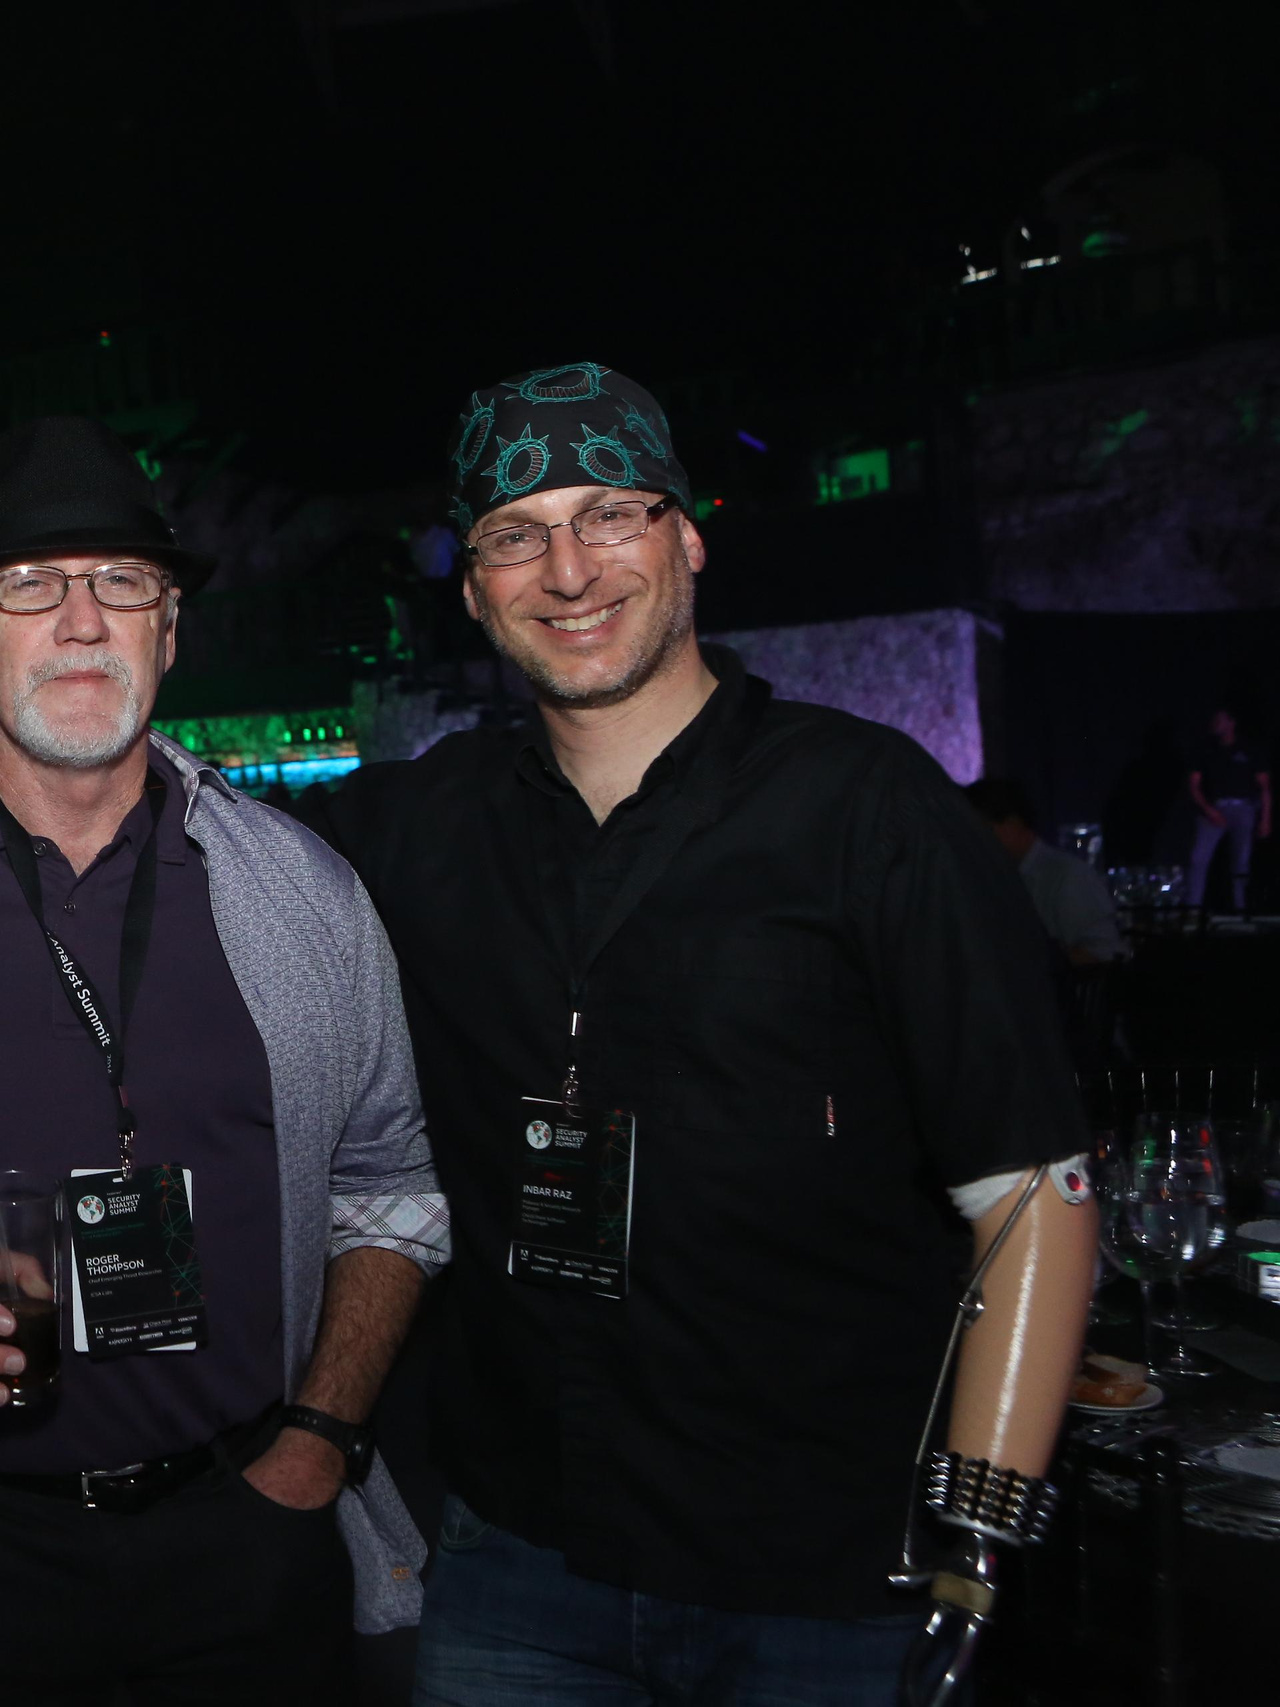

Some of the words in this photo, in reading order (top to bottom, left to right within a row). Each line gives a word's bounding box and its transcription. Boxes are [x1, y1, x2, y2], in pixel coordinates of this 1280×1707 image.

[49, 937, 83, 988] Analyst
[77, 988, 111, 1047] Summit
[555, 1128, 588, 1138] SECURITY
[555, 1134, 584, 1143] ANALYST
[554, 1140, 582, 1149] SUMMIT
[523, 1184, 552, 1197] INBAR
[552, 1188, 573, 1201] RAZ
[107, 1193, 141, 1204] SECURITY
[108, 1200, 139, 1210] ANALYST
[109, 1206, 138, 1216] SUMMIT
[86, 1254, 120, 1267] ROGER
[86, 1259, 145, 1276] THOMPSON
